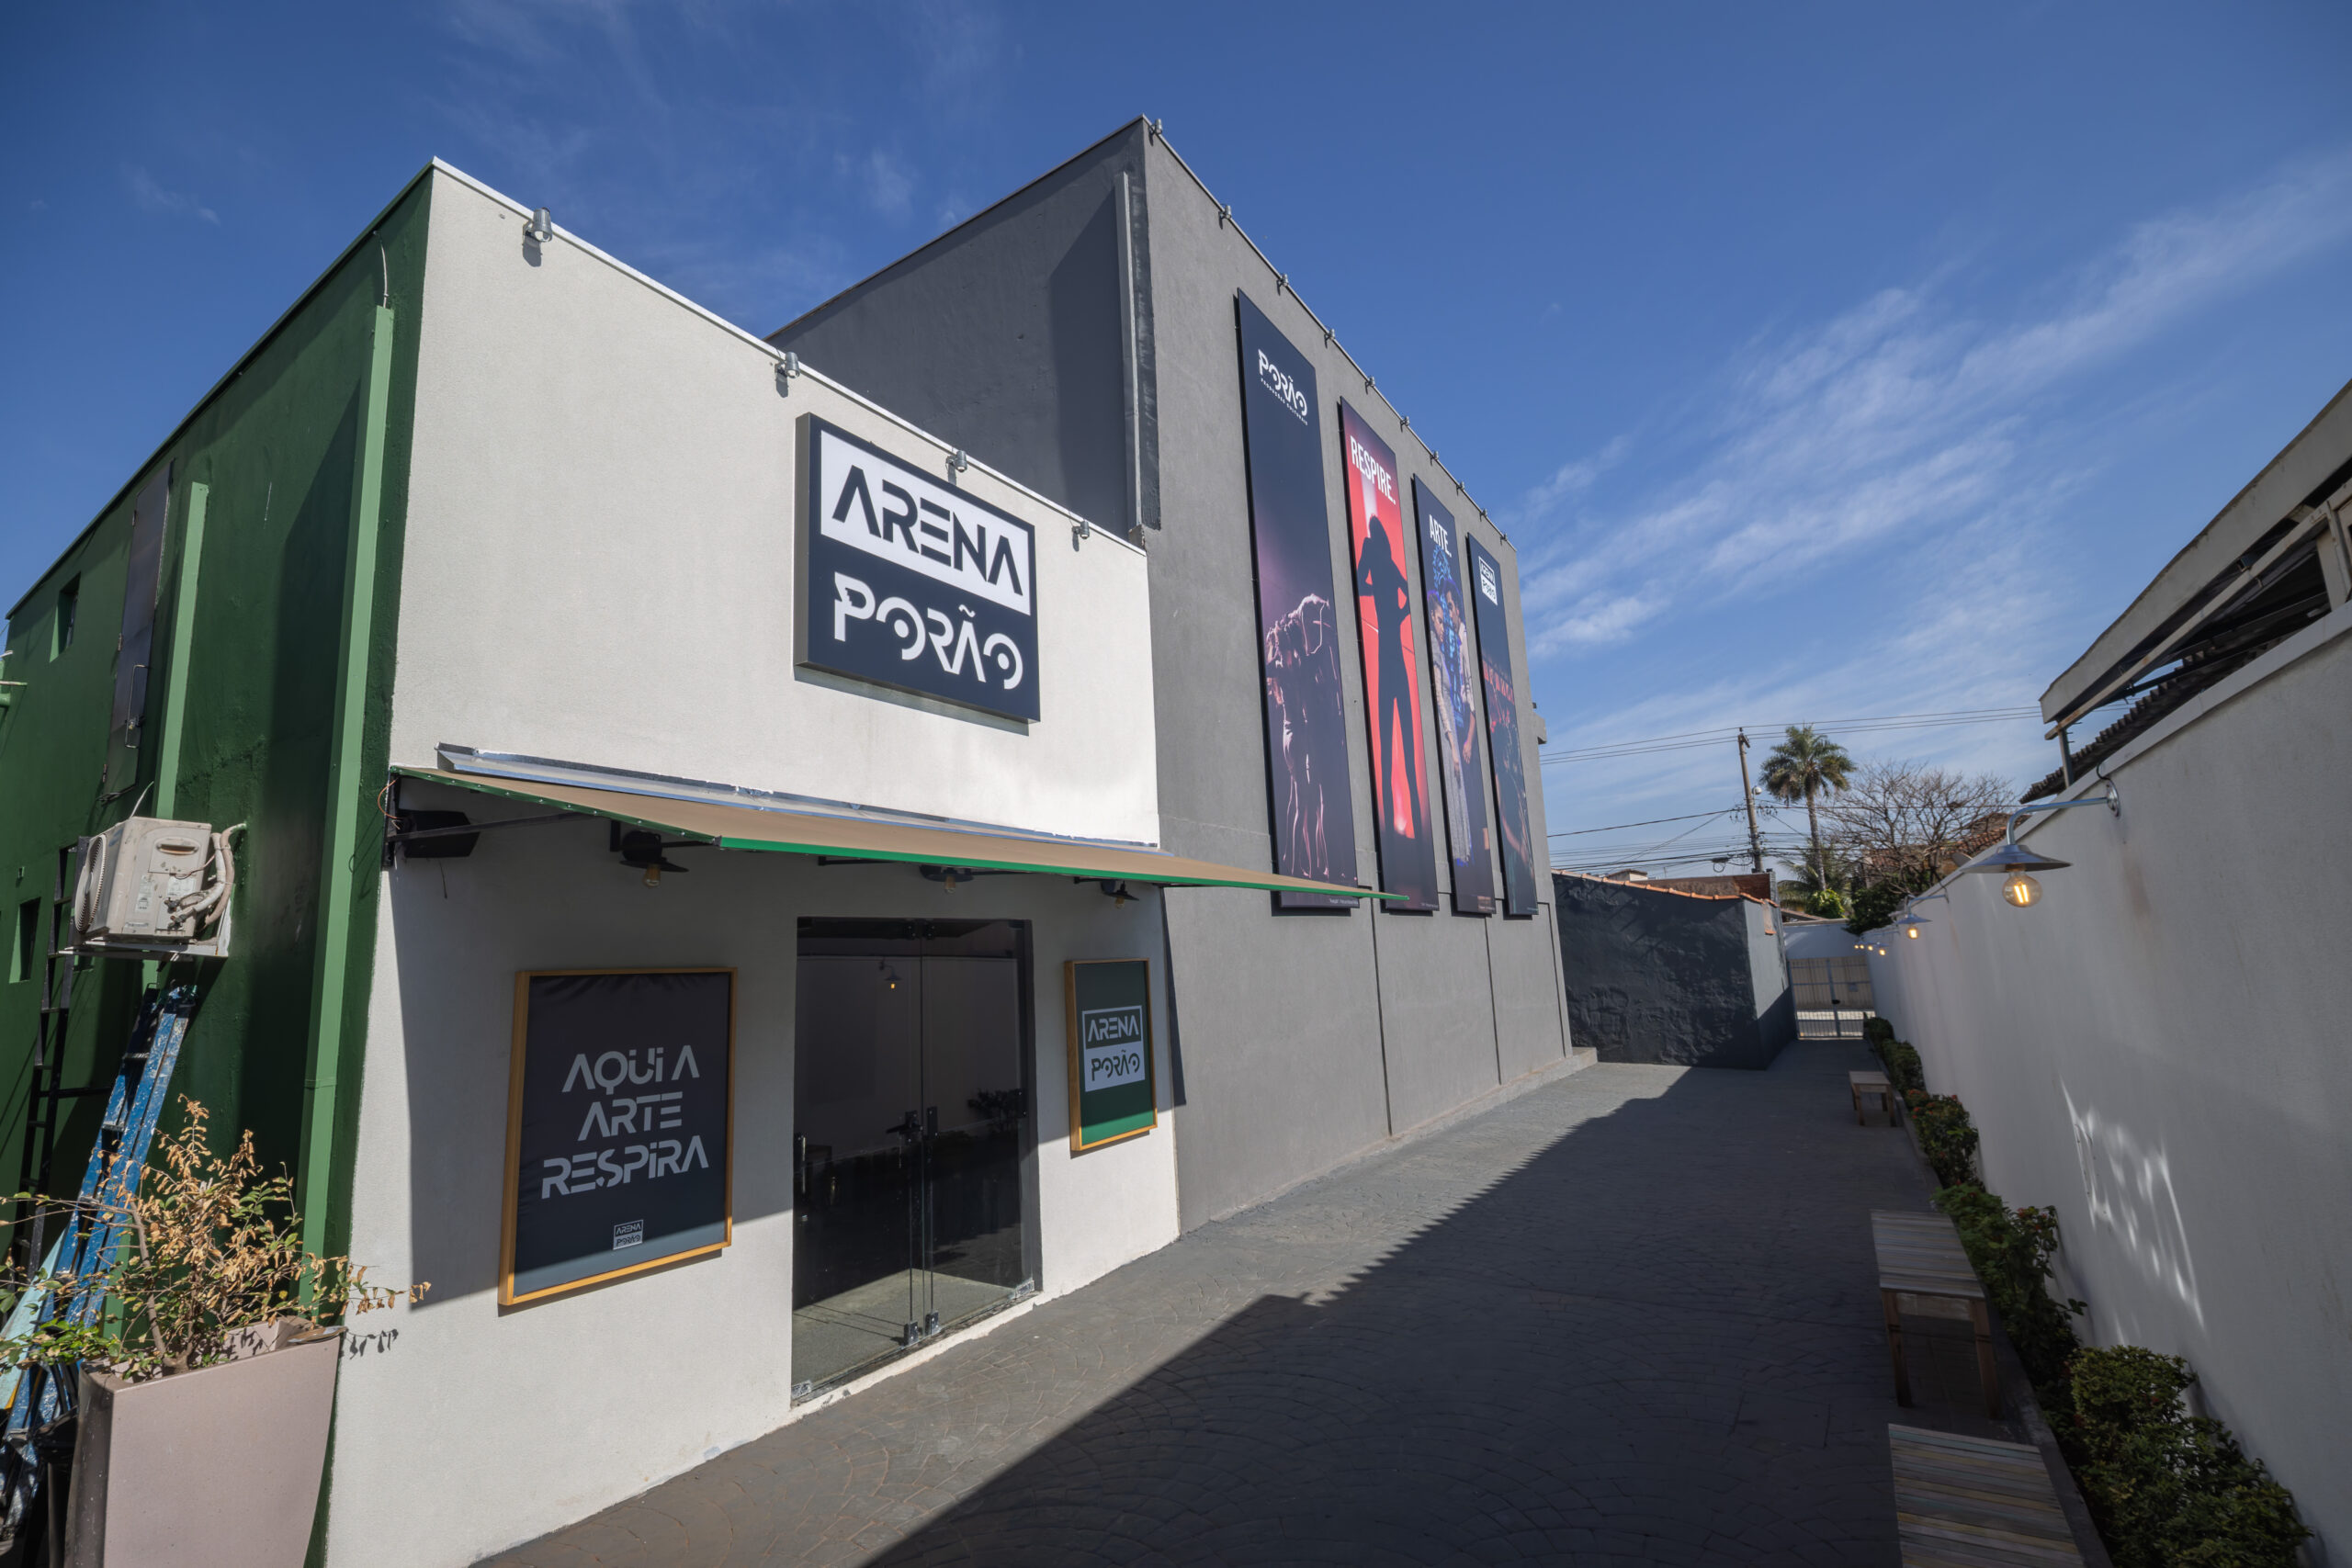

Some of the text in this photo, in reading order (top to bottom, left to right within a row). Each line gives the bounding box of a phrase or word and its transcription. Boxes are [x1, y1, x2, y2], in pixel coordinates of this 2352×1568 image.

[1258, 349, 1307, 416] PORÃO
[1350, 434, 1396, 505] RESPIRE.
[831, 464, 1023, 597] ARENA
[1429, 513, 1452, 558] ARTE.
[834, 570, 1023, 690] PORÃO
[1087, 1014, 1140, 1042] ARENA
[561, 1044, 700, 1095] AQUI A
[1091, 1049, 1140, 1082] PORÃO
[577, 1090, 684, 1142] ARTE
[540, 1134, 709, 1200] RESPIRA
[616, 1222, 641, 1235] ARENA
